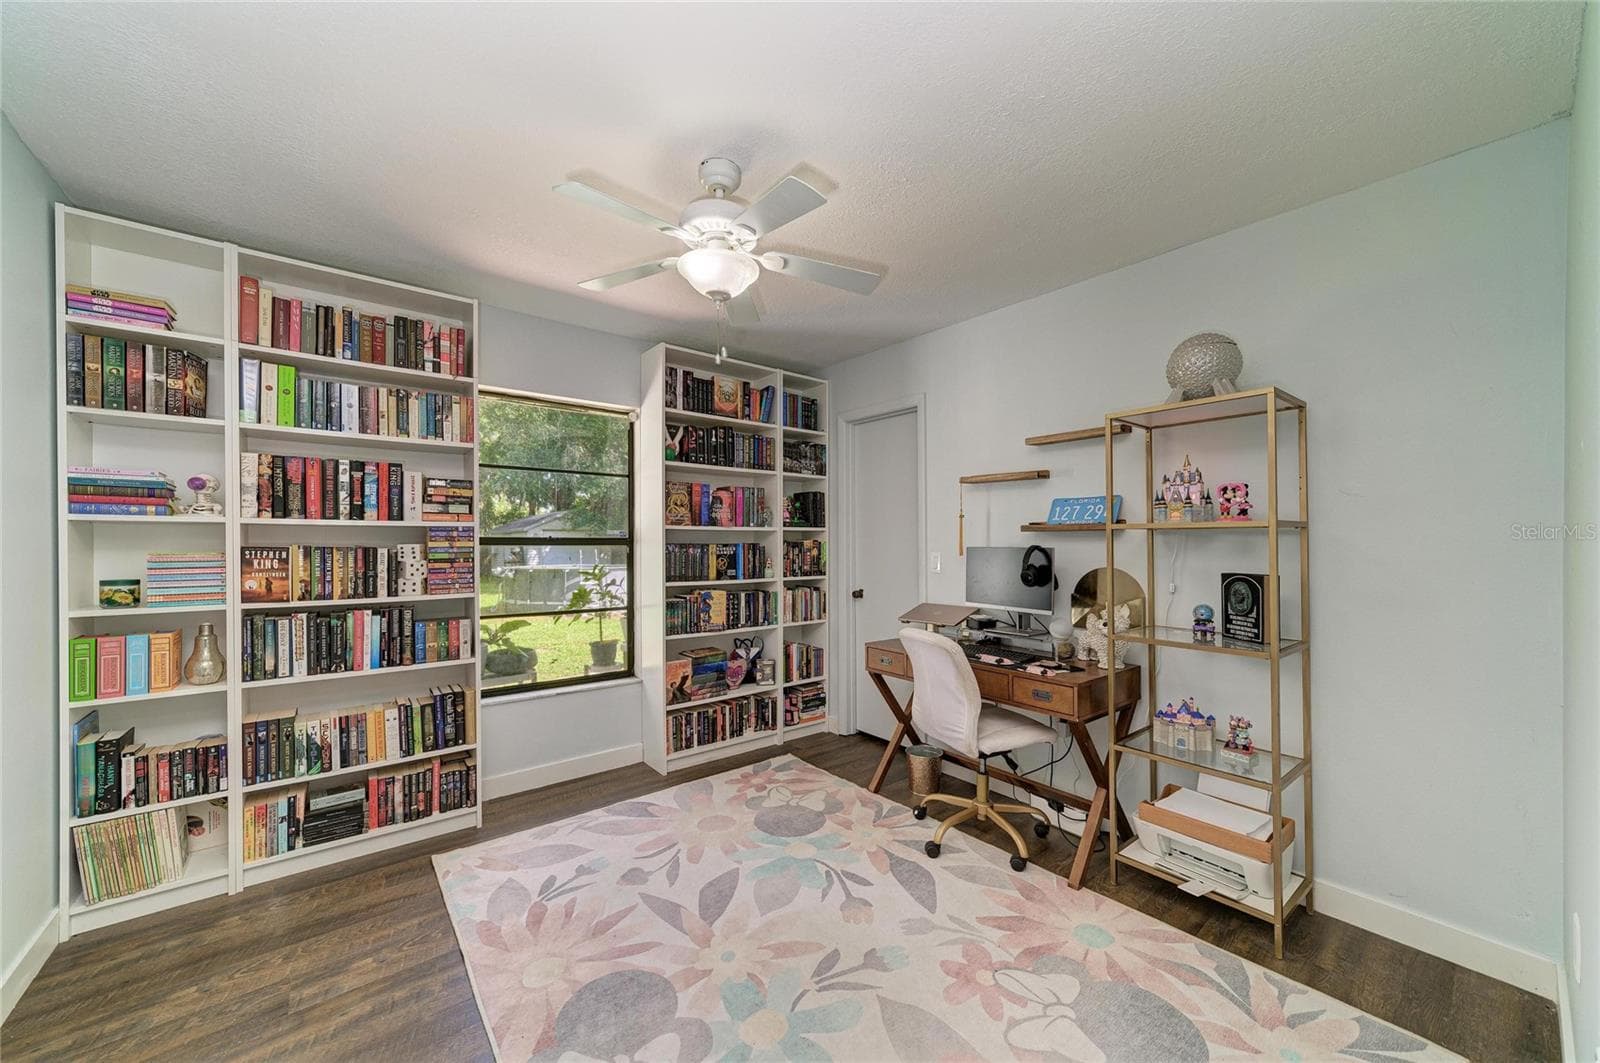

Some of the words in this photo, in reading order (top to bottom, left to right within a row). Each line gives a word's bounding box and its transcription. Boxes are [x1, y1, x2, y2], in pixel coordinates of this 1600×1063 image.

[168, 350, 176, 378] MARTIN
[1053, 506, 1080, 520] 127
[1085, 504, 1107, 519] 29
[245, 551, 287, 559] STEPHEN
[253, 559, 279, 569] KING
